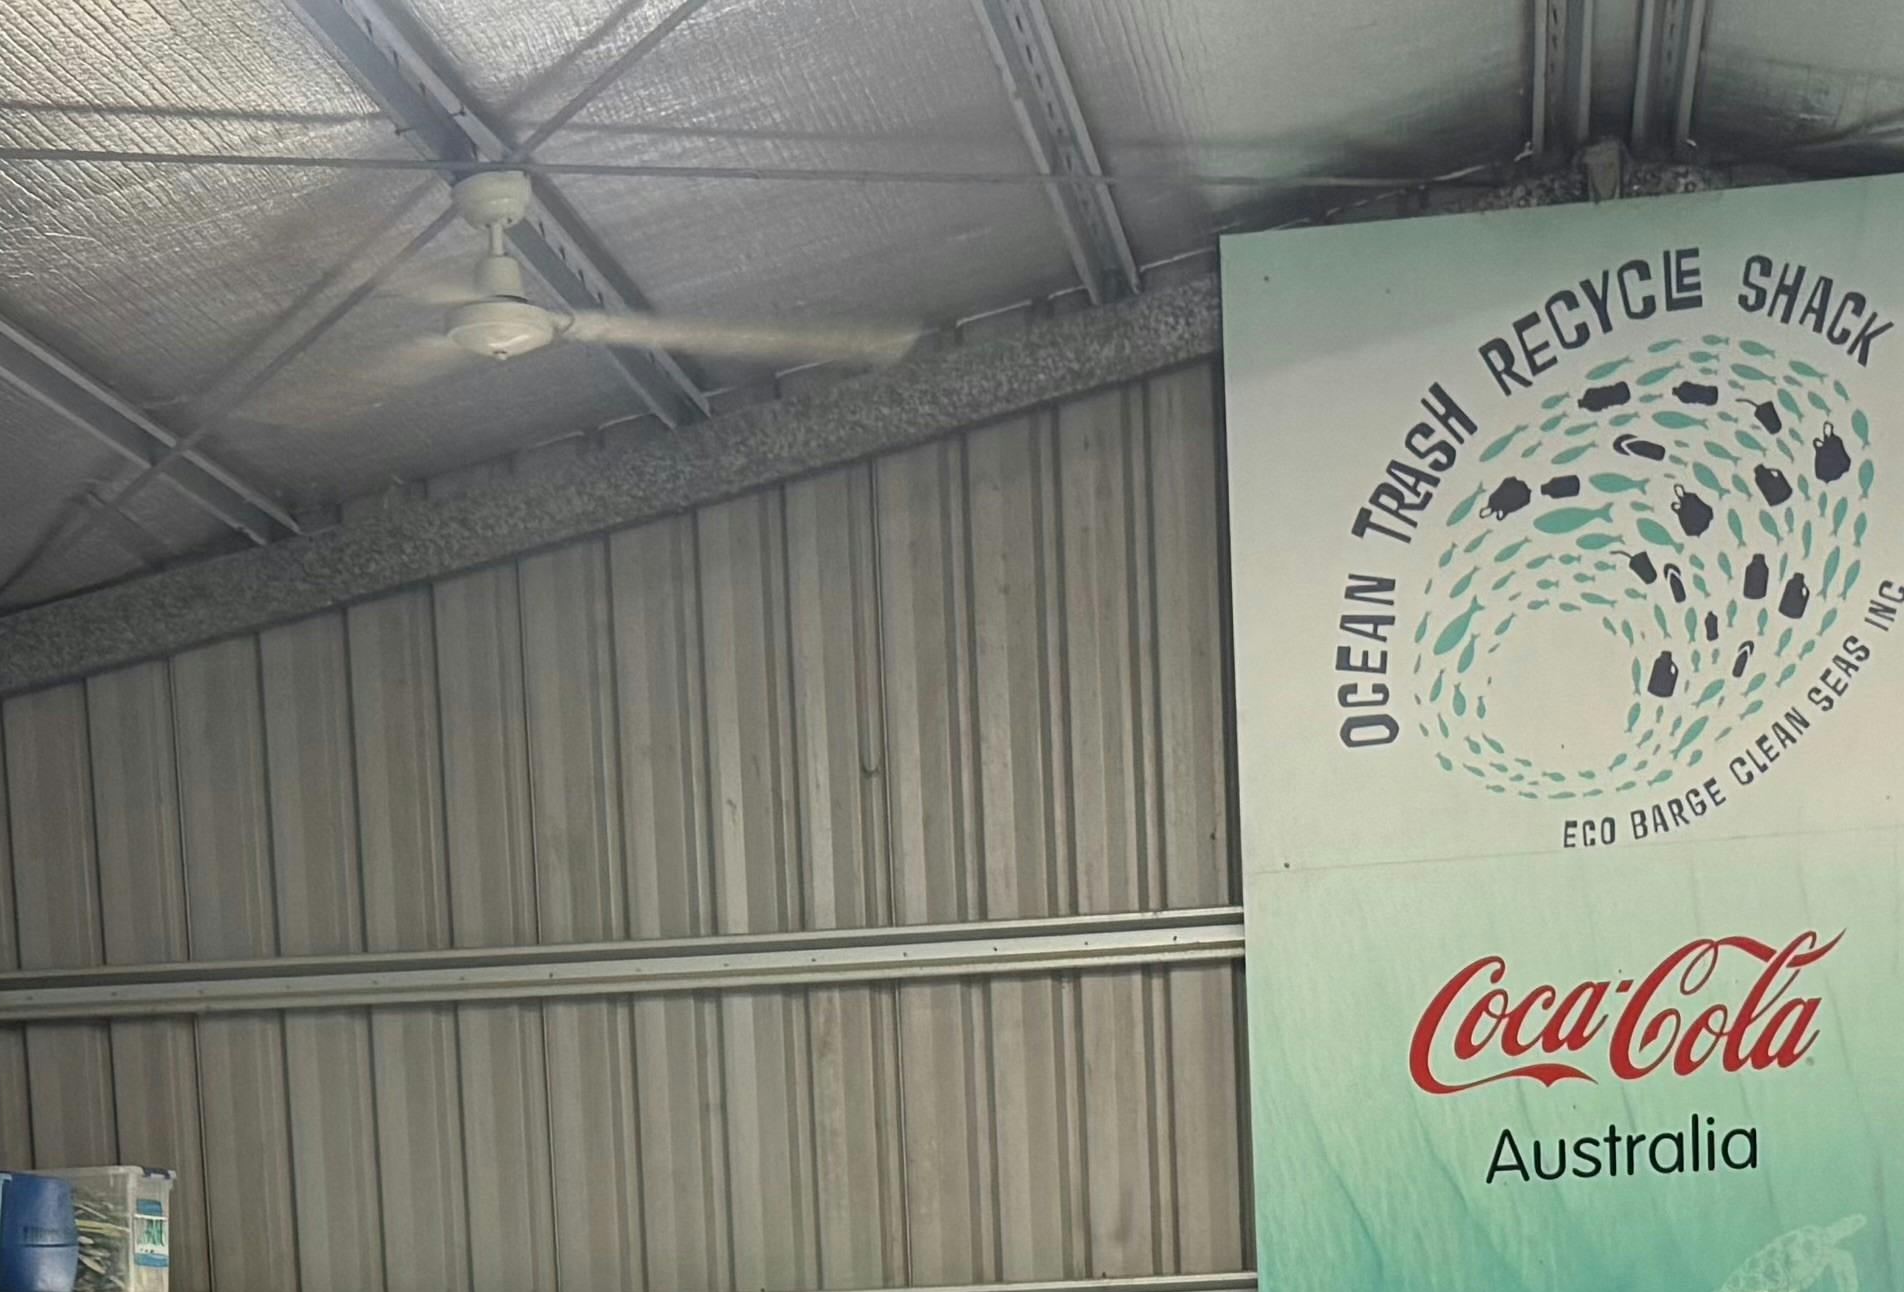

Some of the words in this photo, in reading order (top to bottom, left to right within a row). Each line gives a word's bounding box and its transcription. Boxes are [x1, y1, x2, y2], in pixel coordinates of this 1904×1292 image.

[1478, 246, 1704, 397] RECYCLE
[1736, 253, 1895, 368] SHACK
[1350, 381, 1480, 545] TRASH
[1334, 572, 1400, 750] OCEAN
[1561, 815, 1617, 849] ECO
[1629, 777, 1727, 841] BARGE
[1727, 705, 1812, 788] CLEAN
[1806, 633, 1873, 714] SEAS
[1408, 926, 1848, 1096] Coca-Cola
[1484, 1112, 1760, 1186] Australia
